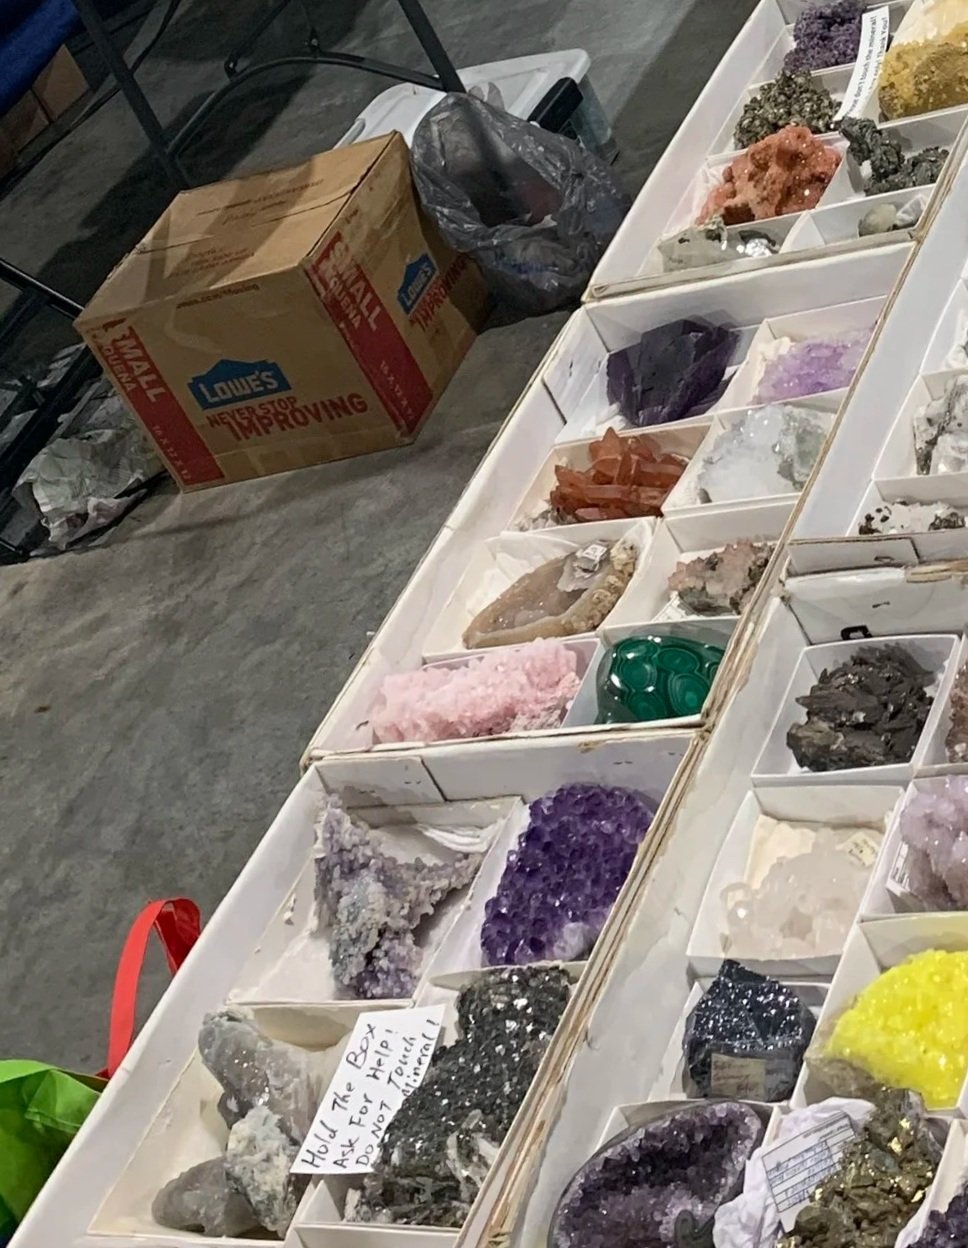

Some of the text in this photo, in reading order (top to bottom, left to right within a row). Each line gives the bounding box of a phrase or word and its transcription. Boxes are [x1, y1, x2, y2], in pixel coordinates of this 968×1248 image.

[199, 370, 281, 403] LOWE'S
[207, 395, 298, 429] NEVER STOP
[226, 392, 369, 443] IMPROVING
[333, 1028, 398, 1169] Ask For Help!
[371, 1099, 392, 1140] NOT
[386, 1035, 417, 1090] Touch
[301, 1119, 340, 1169] Hold
[331, 1081, 356, 1112] The
